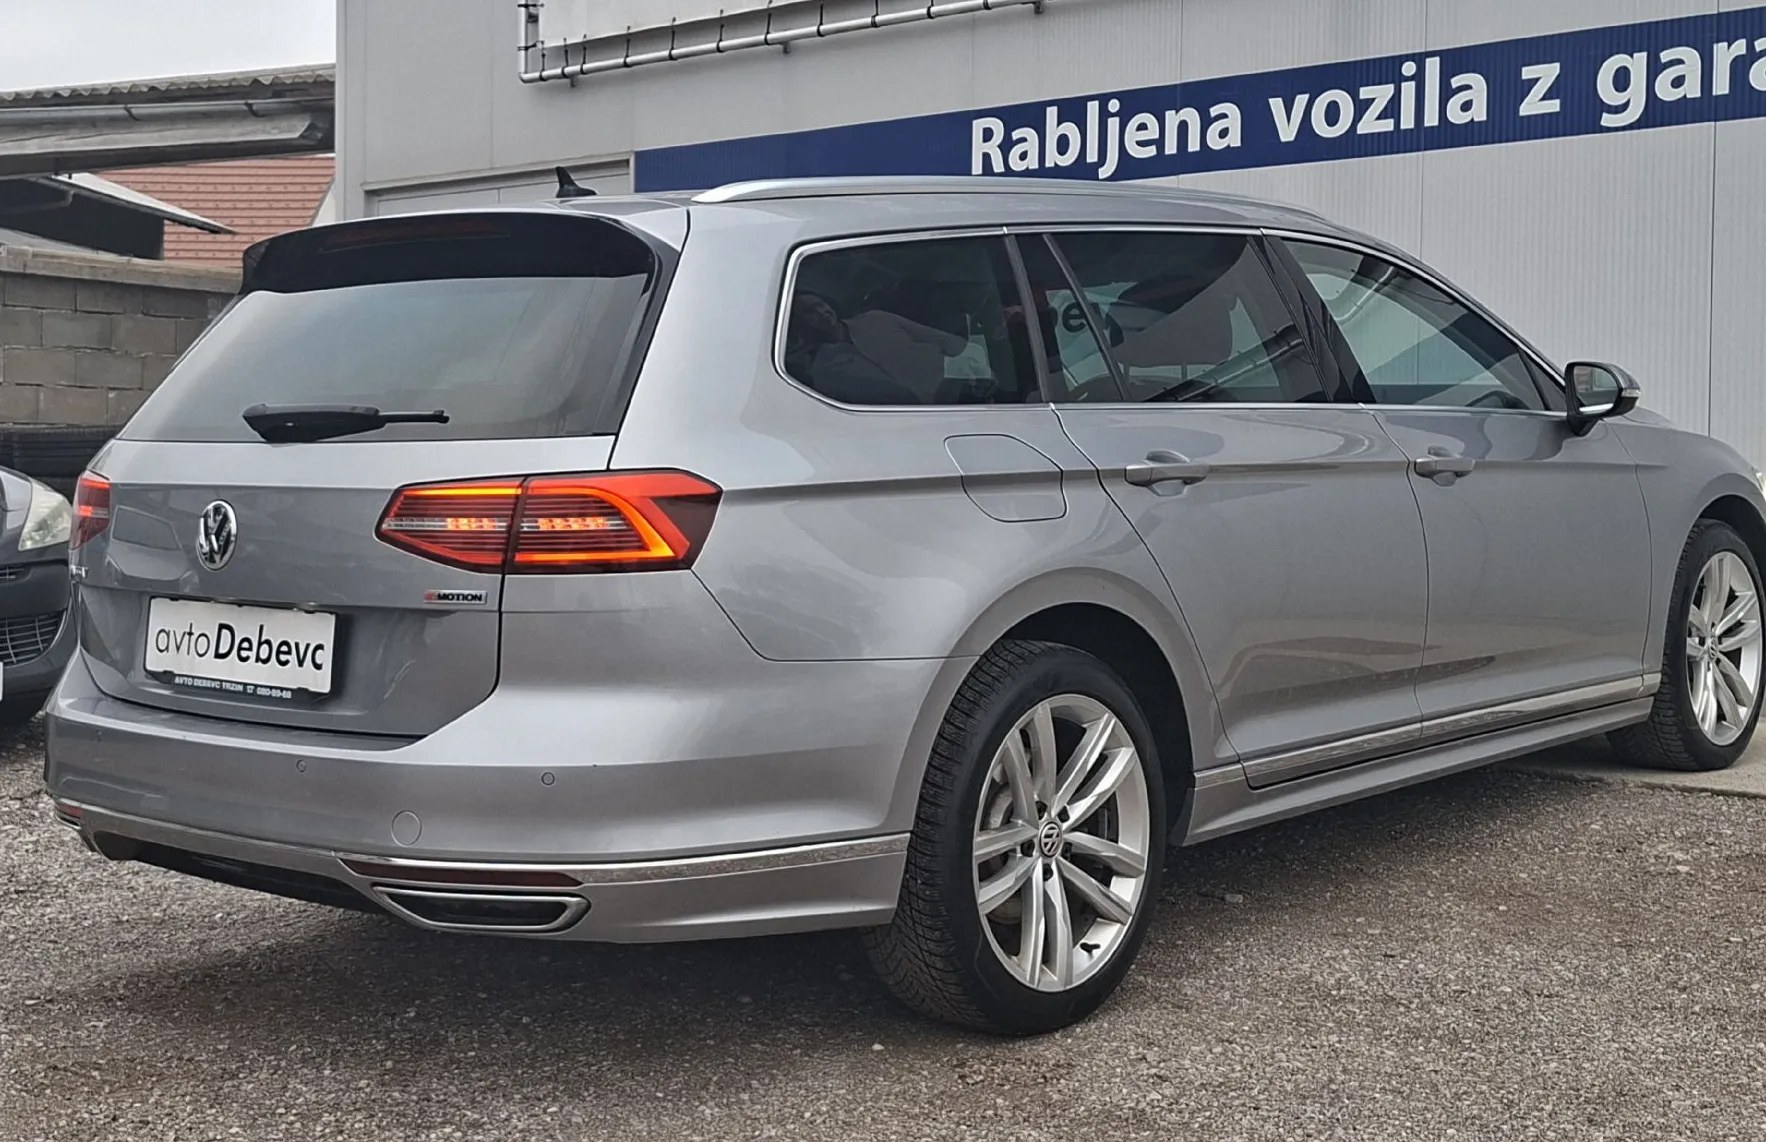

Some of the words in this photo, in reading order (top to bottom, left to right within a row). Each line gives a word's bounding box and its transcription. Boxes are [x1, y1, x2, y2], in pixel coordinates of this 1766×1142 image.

[971, 98, 1242, 180] Rabljena
[1268, 56, 1488, 143] vozila
[1518, 62, 1561, 117] z
[174, 676, 193, 686] AVTO
